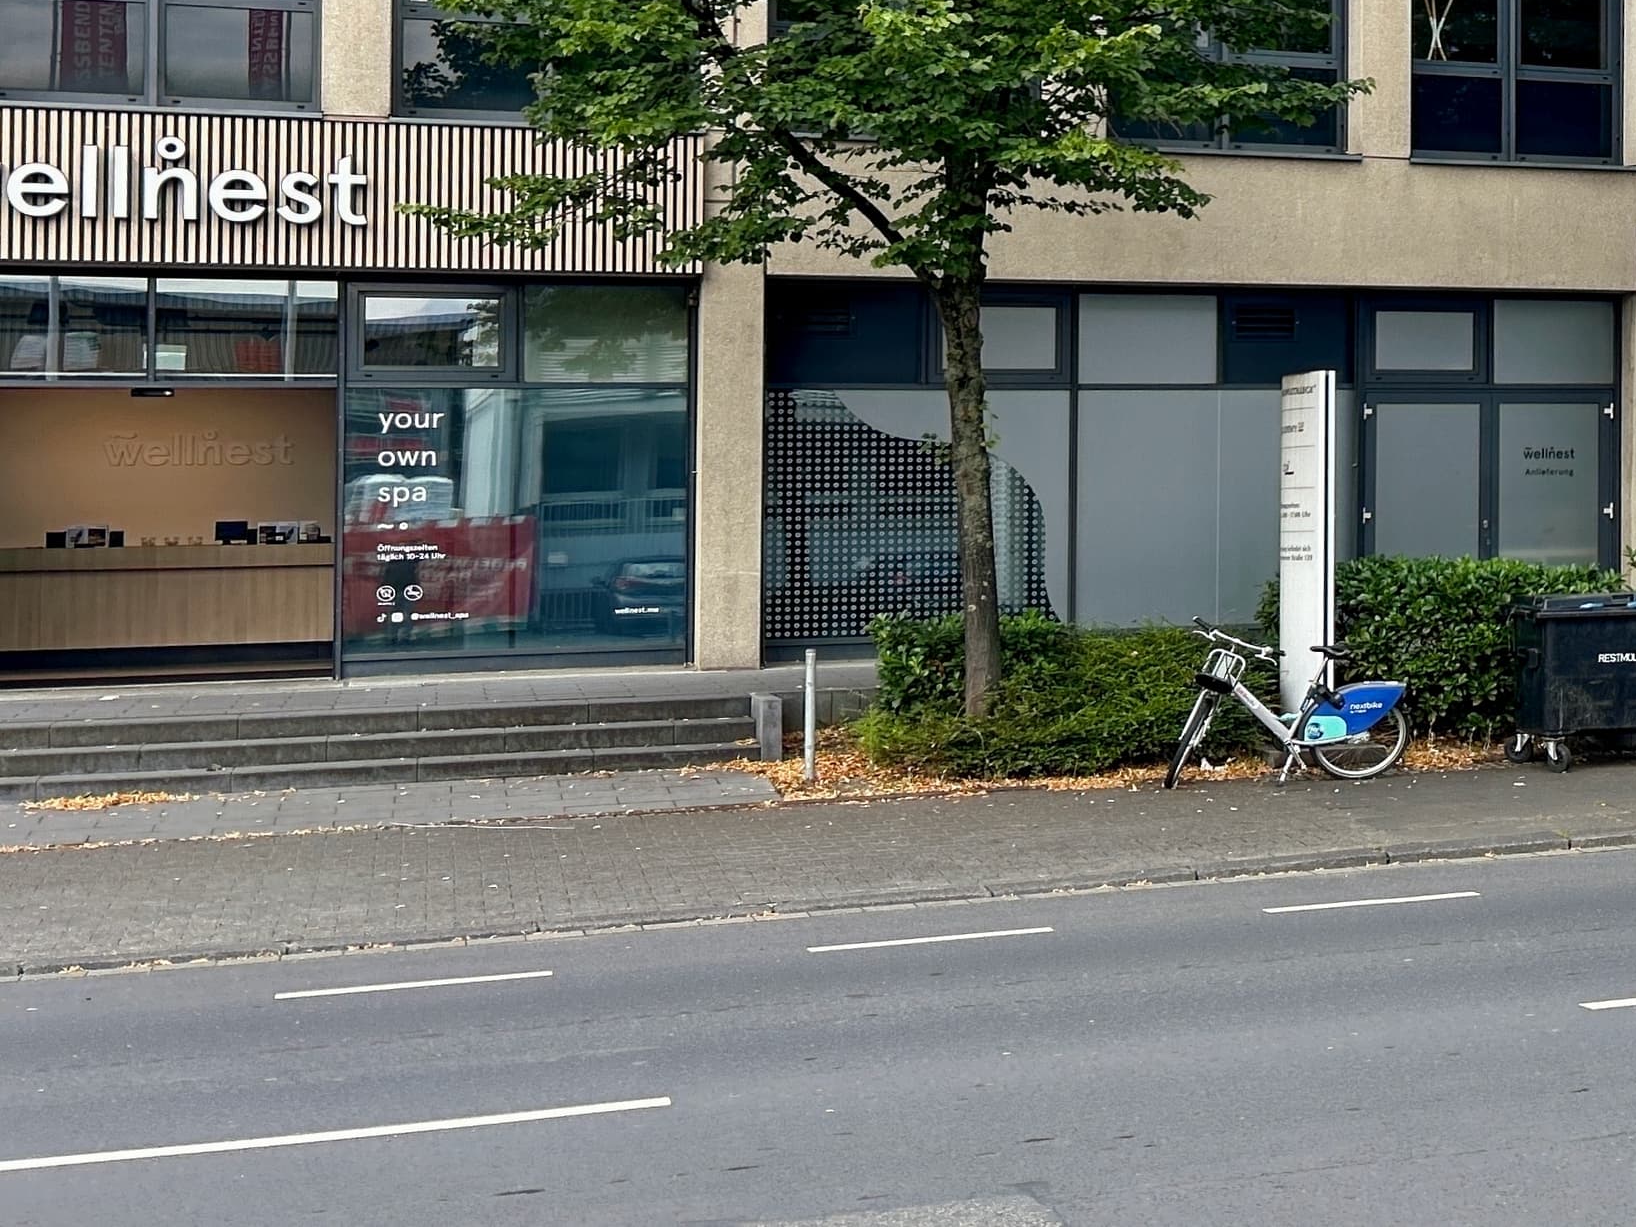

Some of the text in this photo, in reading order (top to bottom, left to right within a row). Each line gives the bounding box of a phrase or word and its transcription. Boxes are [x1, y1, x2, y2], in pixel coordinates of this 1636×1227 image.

[0, 136, 368, 225] ellnest
[379, 412, 445, 434] your
[378, 450, 437, 467] own
[378, 485, 427, 508] spa
[1350, 702, 1383, 710] nextbike
